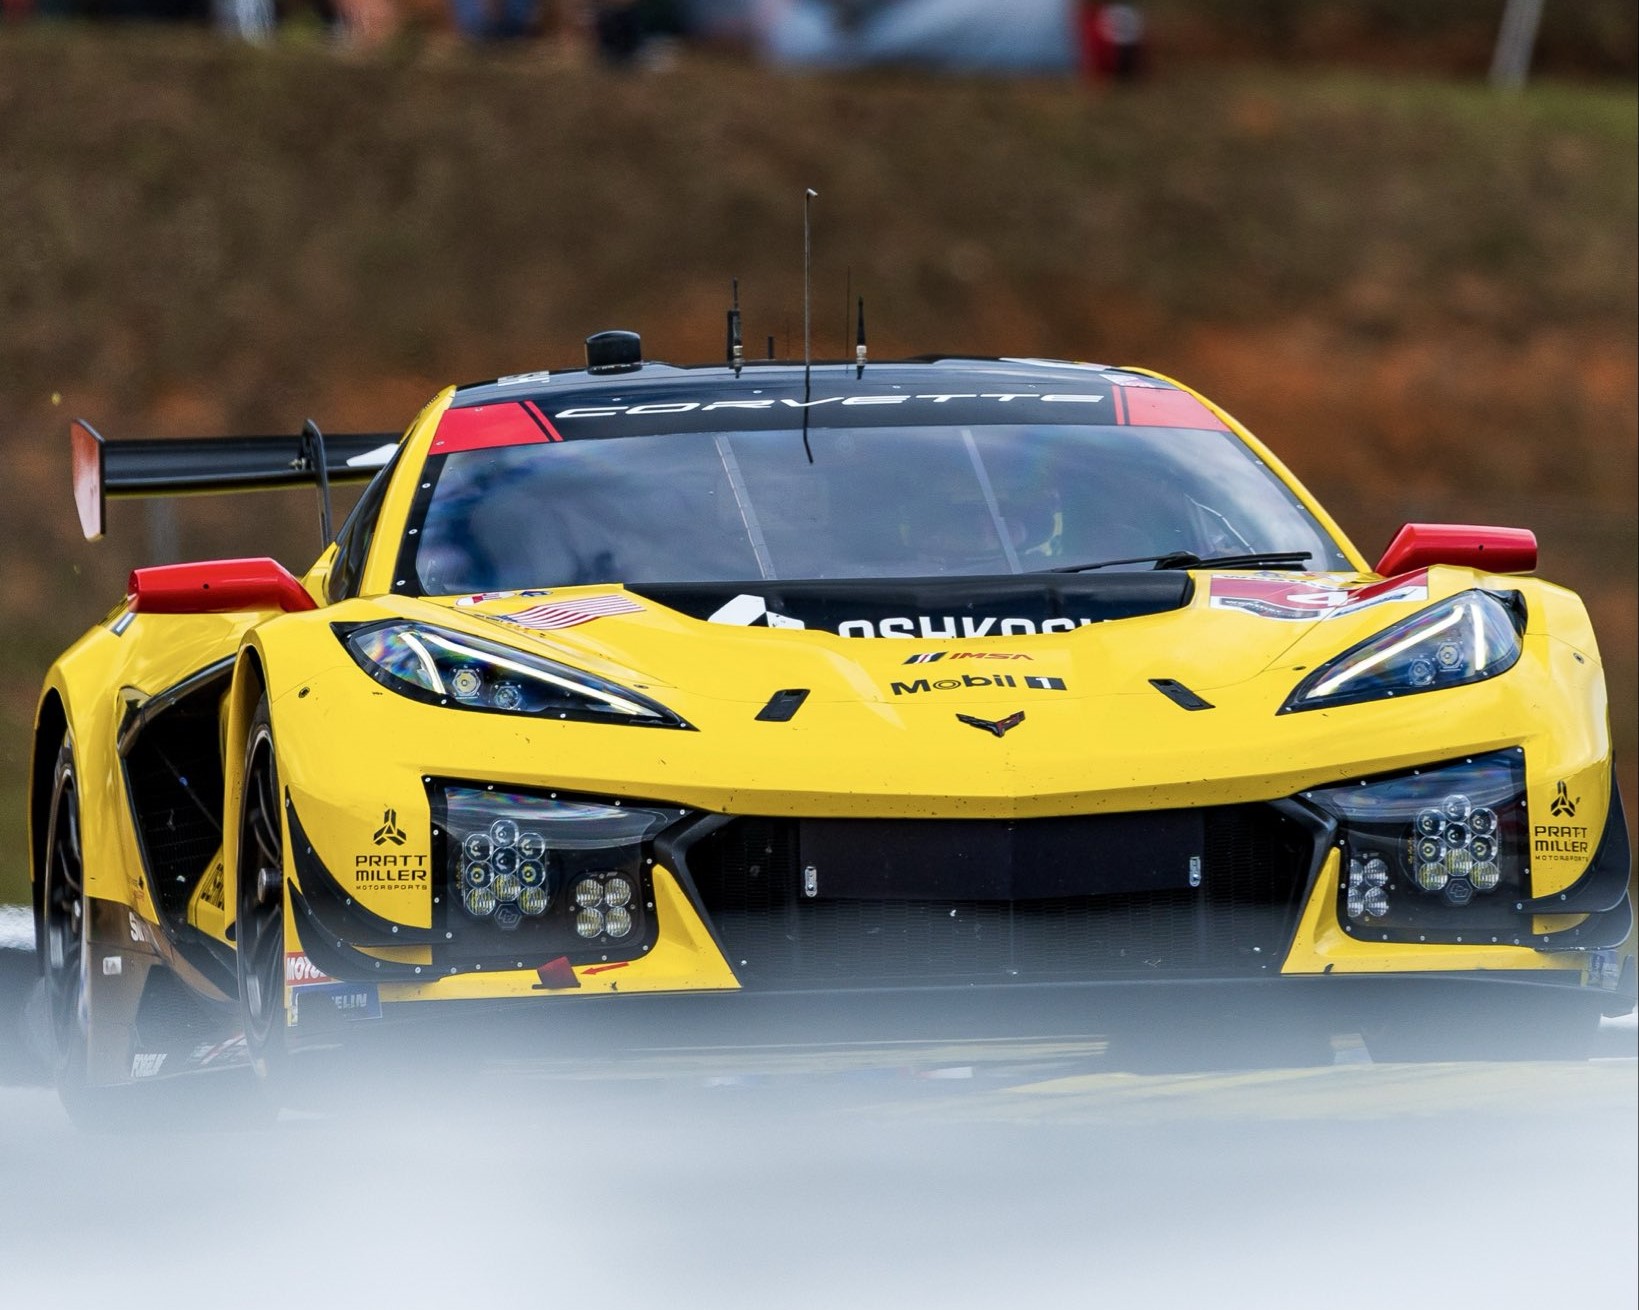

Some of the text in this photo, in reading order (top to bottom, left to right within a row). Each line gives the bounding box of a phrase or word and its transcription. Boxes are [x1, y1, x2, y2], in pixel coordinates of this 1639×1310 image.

[555, 394, 1104, 418] CORVETTE
[949, 652, 1034, 661] IMSA
[890, 674, 1017, 695] Mobil
[1534, 826, 1588, 839] PRATT
[1535, 840, 1588, 853] MILLER
[355, 855, 427, 867] PRATT
[355, 870, 427, 881] MILLER
